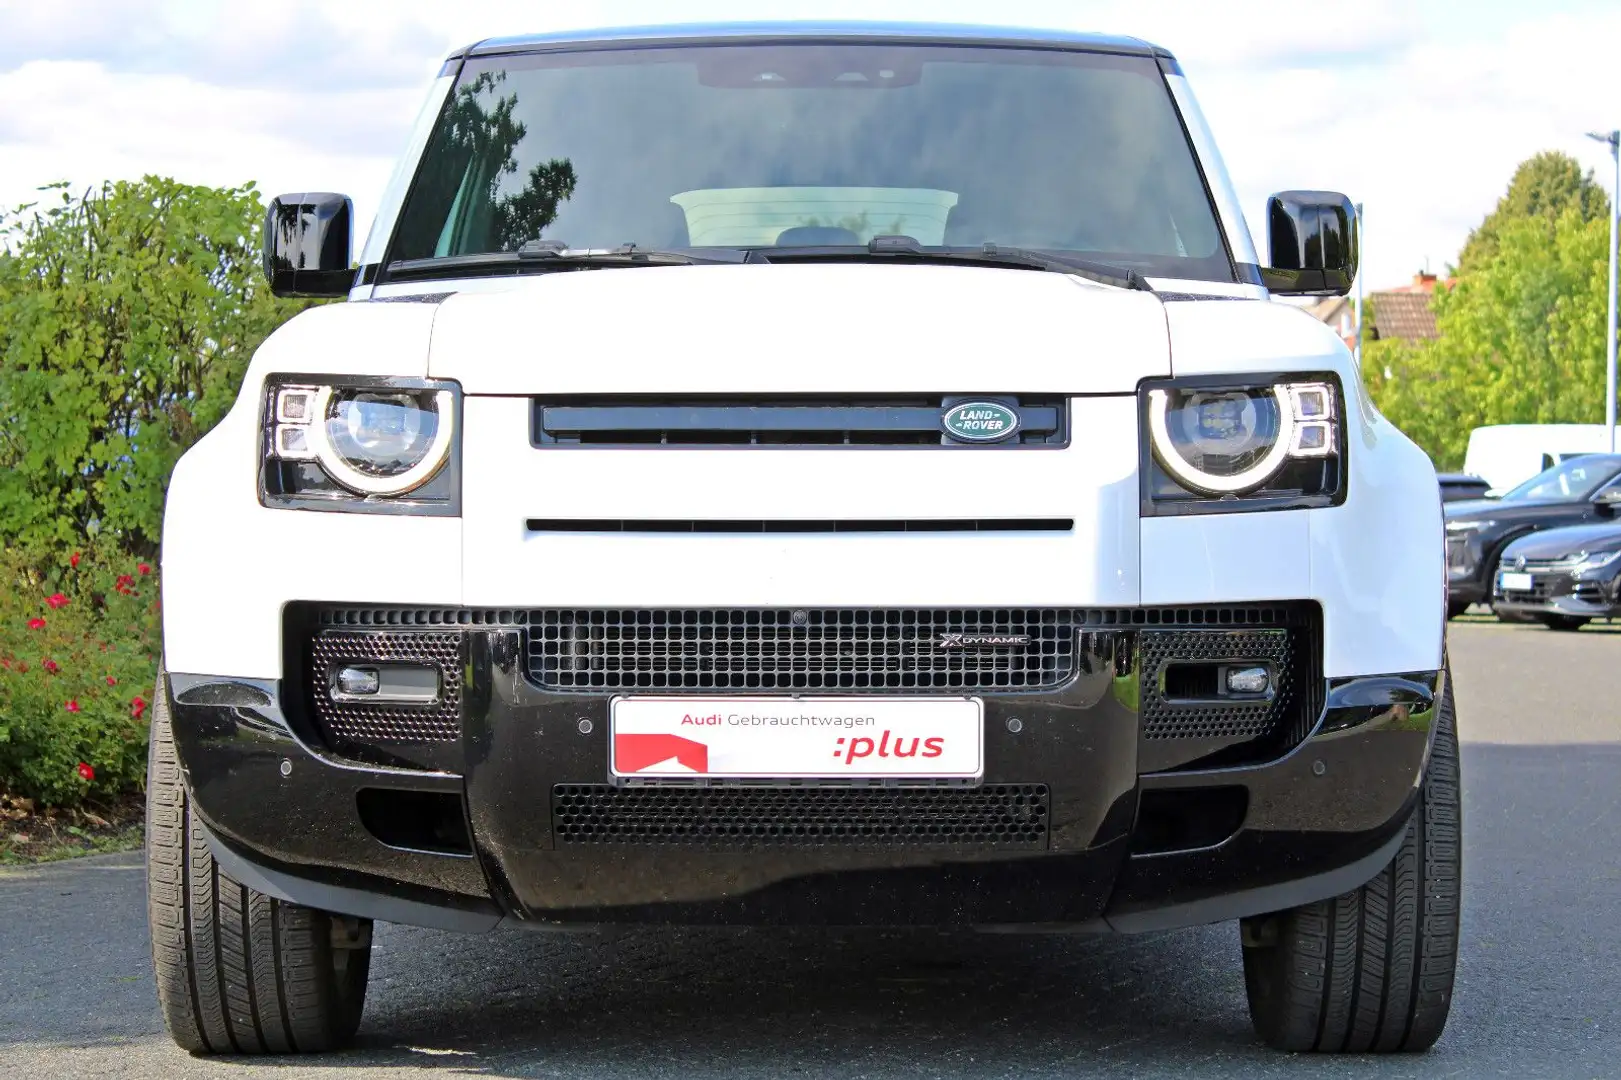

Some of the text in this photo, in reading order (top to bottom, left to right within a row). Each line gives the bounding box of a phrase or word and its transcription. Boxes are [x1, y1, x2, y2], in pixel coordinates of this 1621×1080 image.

[681, 713, 875, 729] Audi Gebrauchtwagen
[833, 730, 945, 765] :plus
